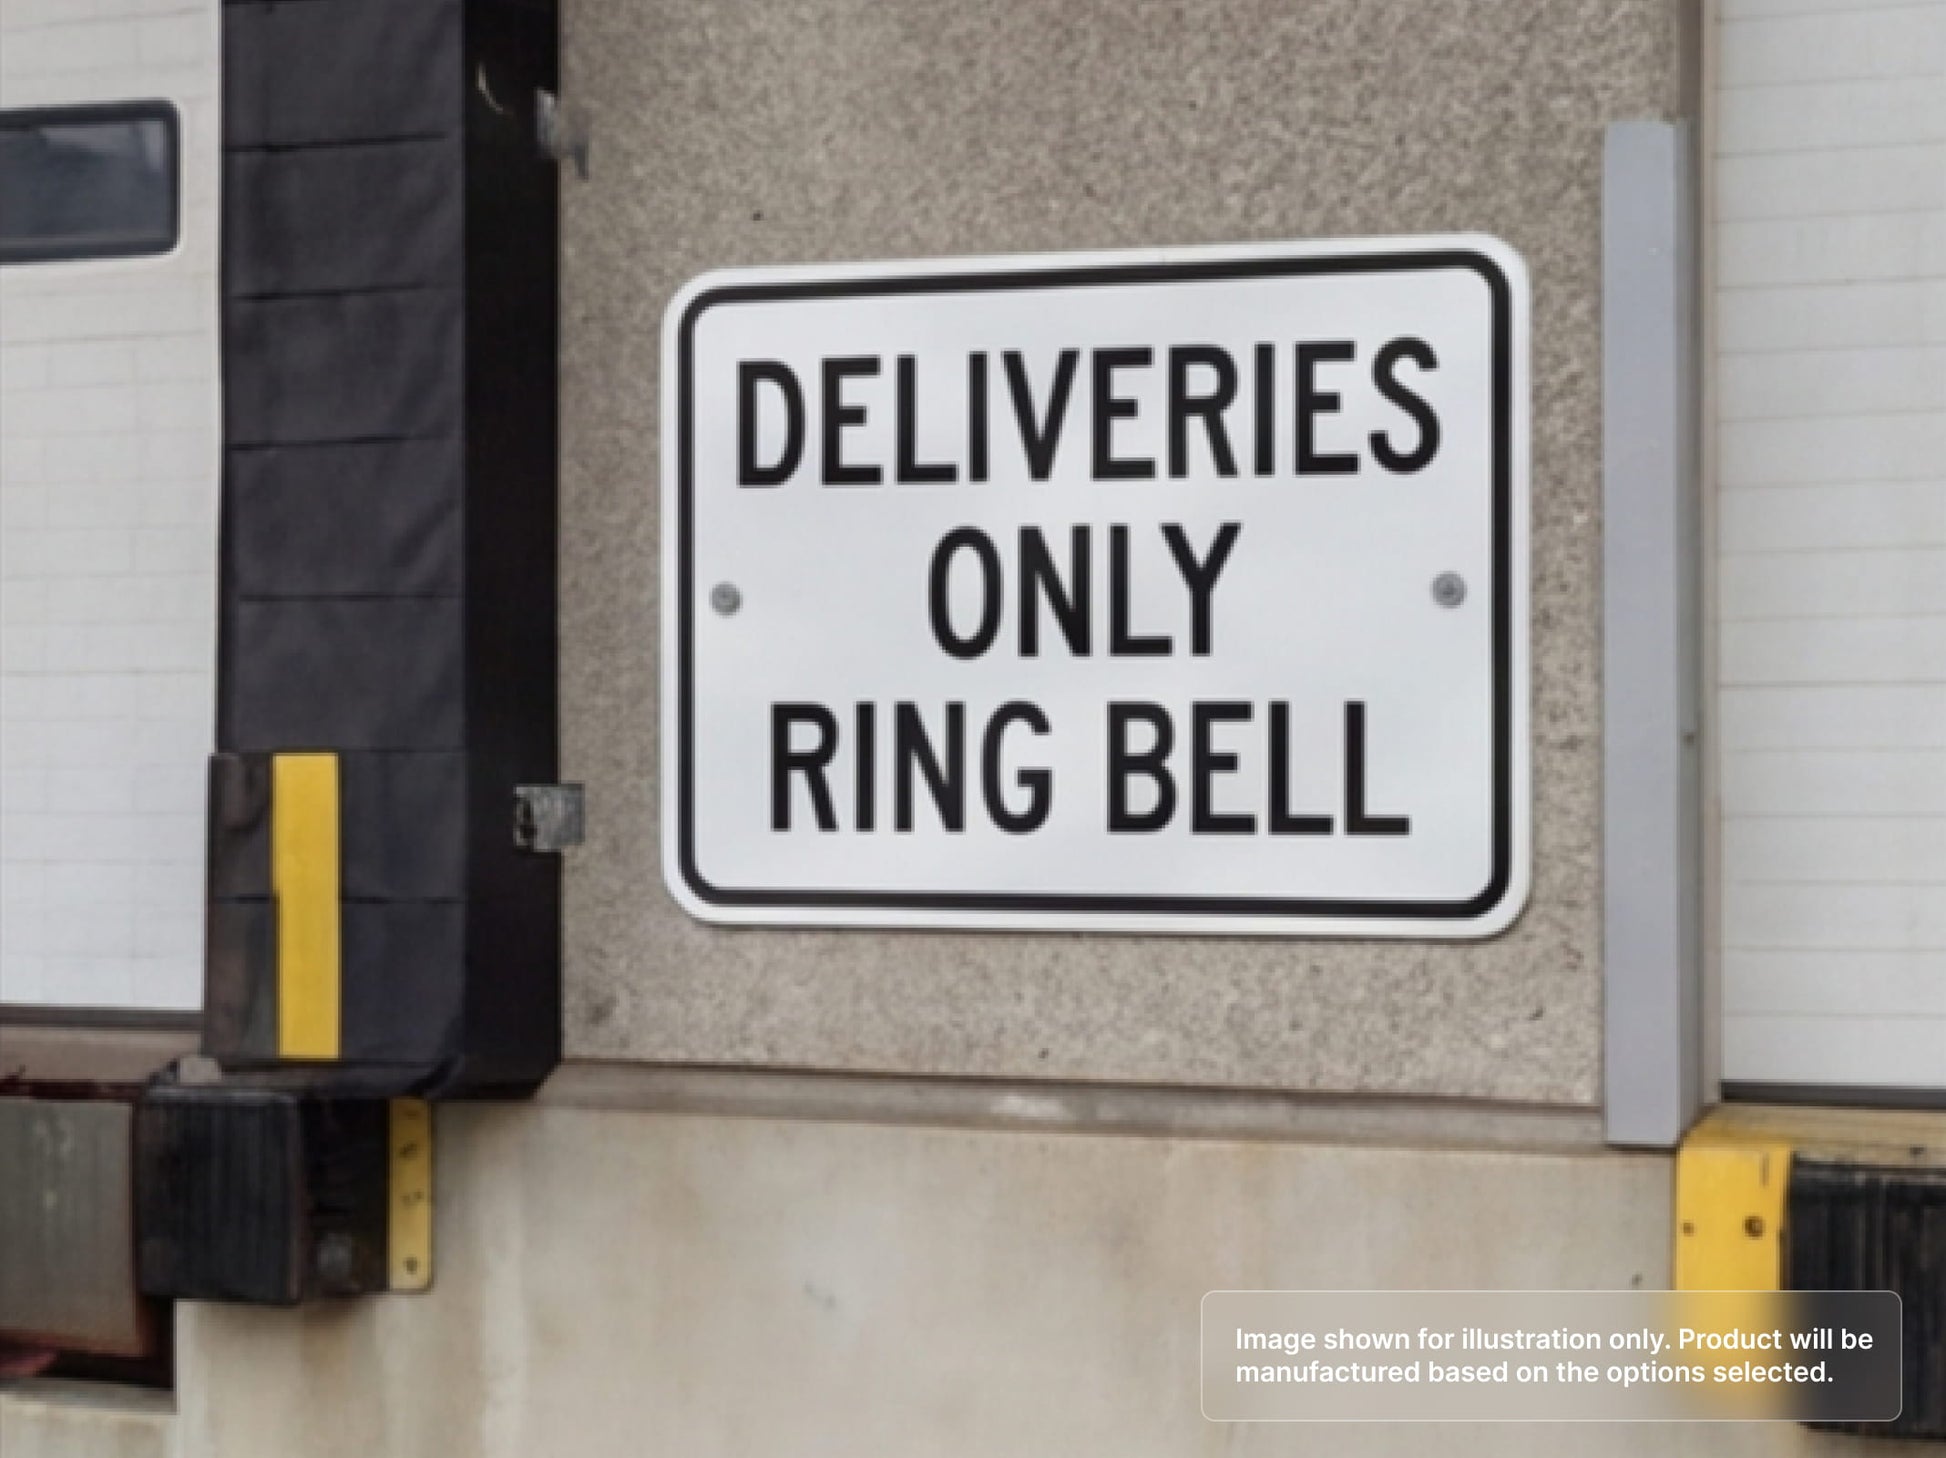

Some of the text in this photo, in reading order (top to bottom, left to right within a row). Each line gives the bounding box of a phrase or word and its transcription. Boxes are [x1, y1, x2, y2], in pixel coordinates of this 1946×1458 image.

[738, 337, 1441, 489] DELIVERIES
[928, 522, 1242, 661] ONLY
[770, 700, 1410, 836] RING BELL
